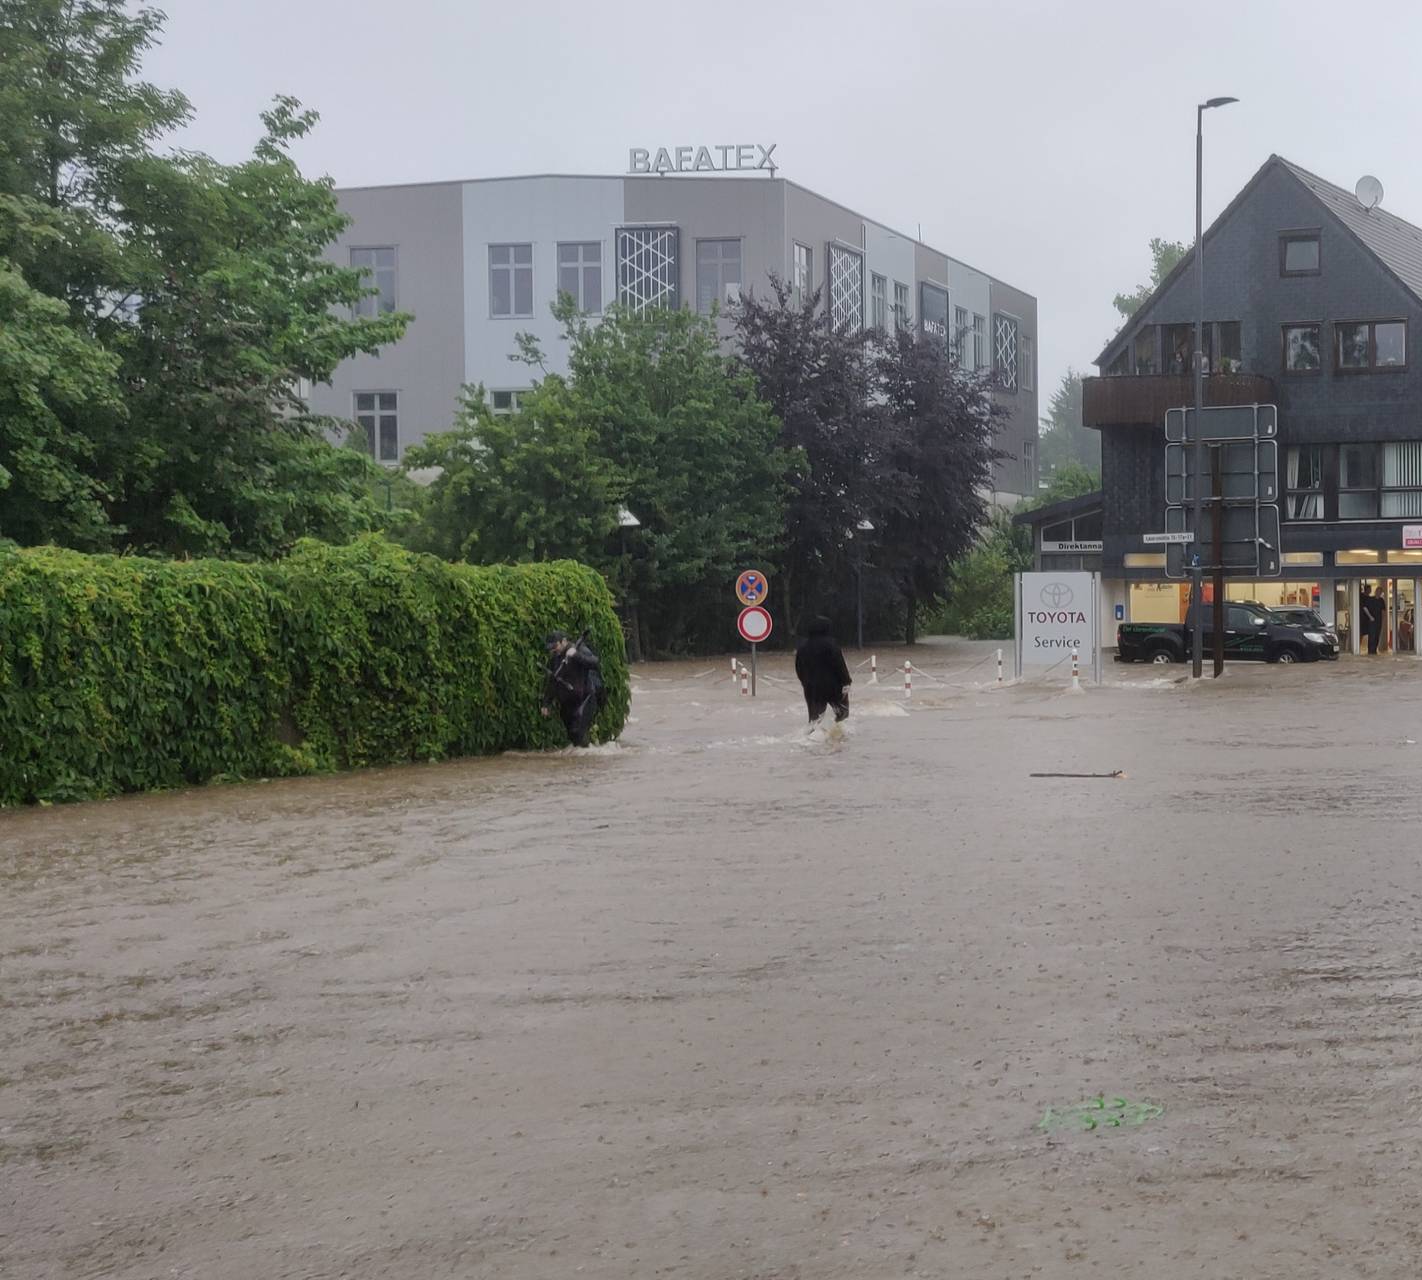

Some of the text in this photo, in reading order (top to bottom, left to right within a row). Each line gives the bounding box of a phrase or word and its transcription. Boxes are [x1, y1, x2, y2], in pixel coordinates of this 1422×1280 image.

[629, 144, 778, 173] BAFATEX
[1027, 611, 1087, 624] TOYOTA
[1034, 635, 1081, 648] Service
